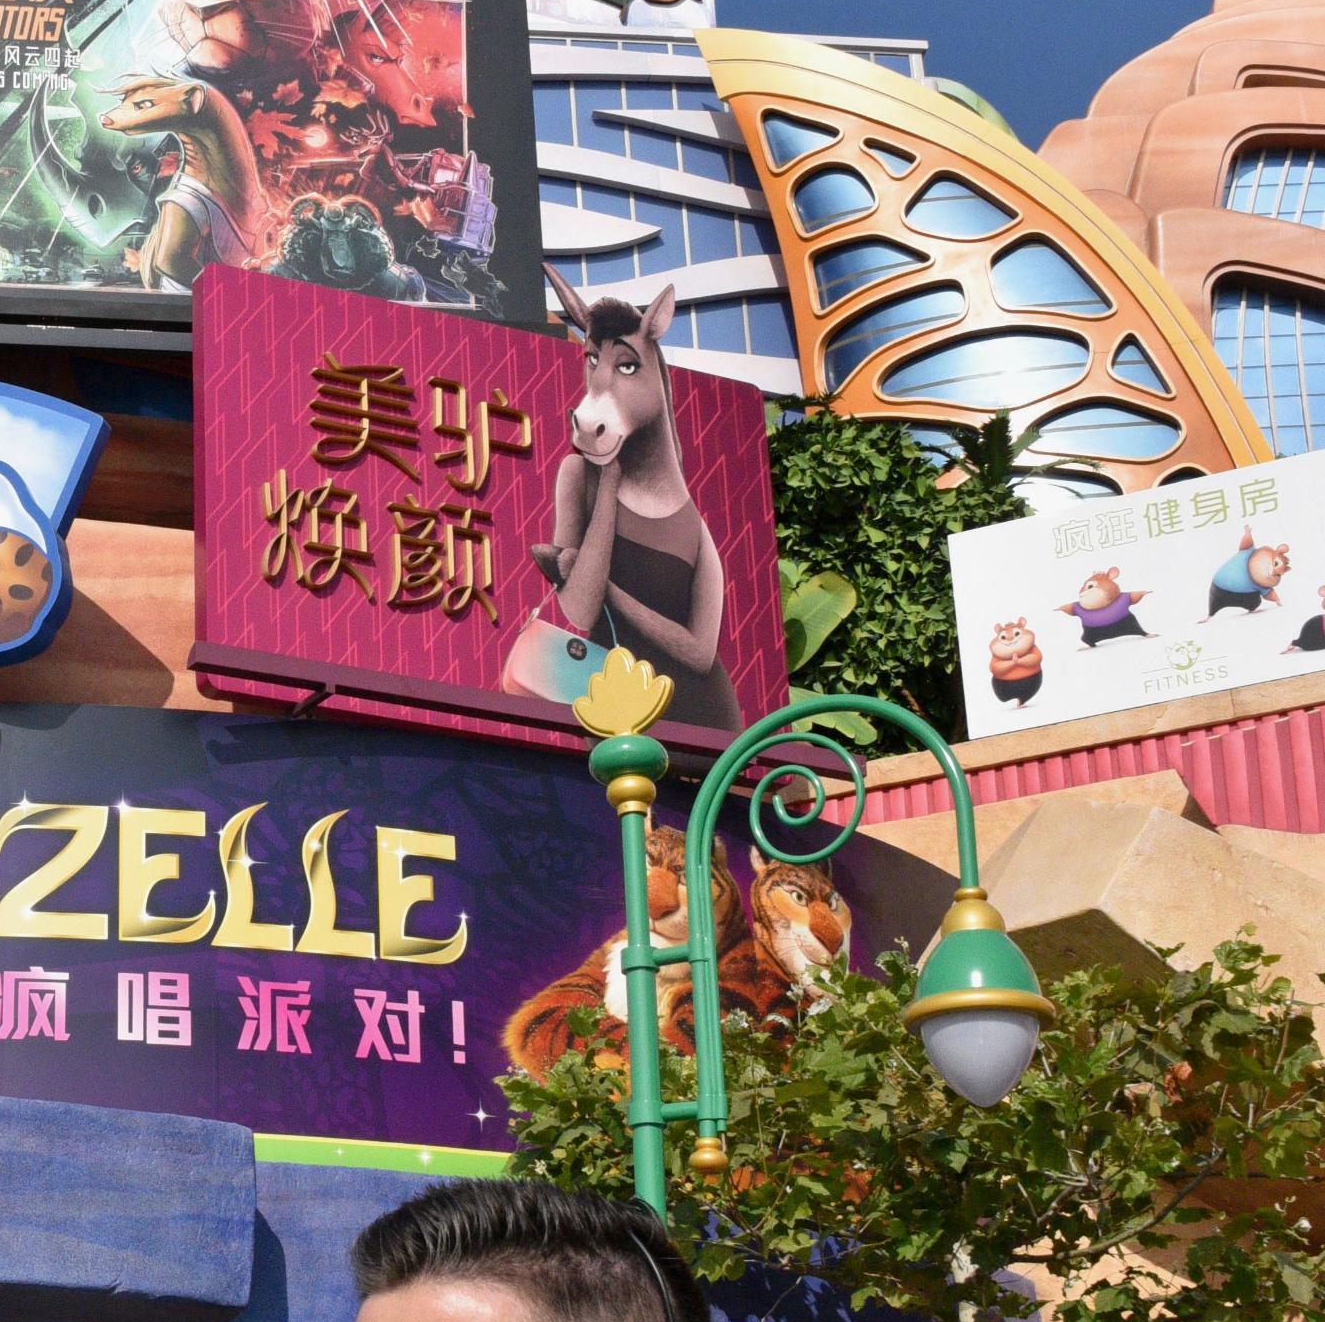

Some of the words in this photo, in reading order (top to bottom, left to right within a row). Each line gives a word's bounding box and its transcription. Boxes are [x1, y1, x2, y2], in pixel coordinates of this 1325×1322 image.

[309, 351, 532, 491] 美驴
[262, 469, 499, 626] 焕颜
[1052, 477, 1279, 559] 疯狂健身房
[1144, 665, 1229, 693] FITNESS
